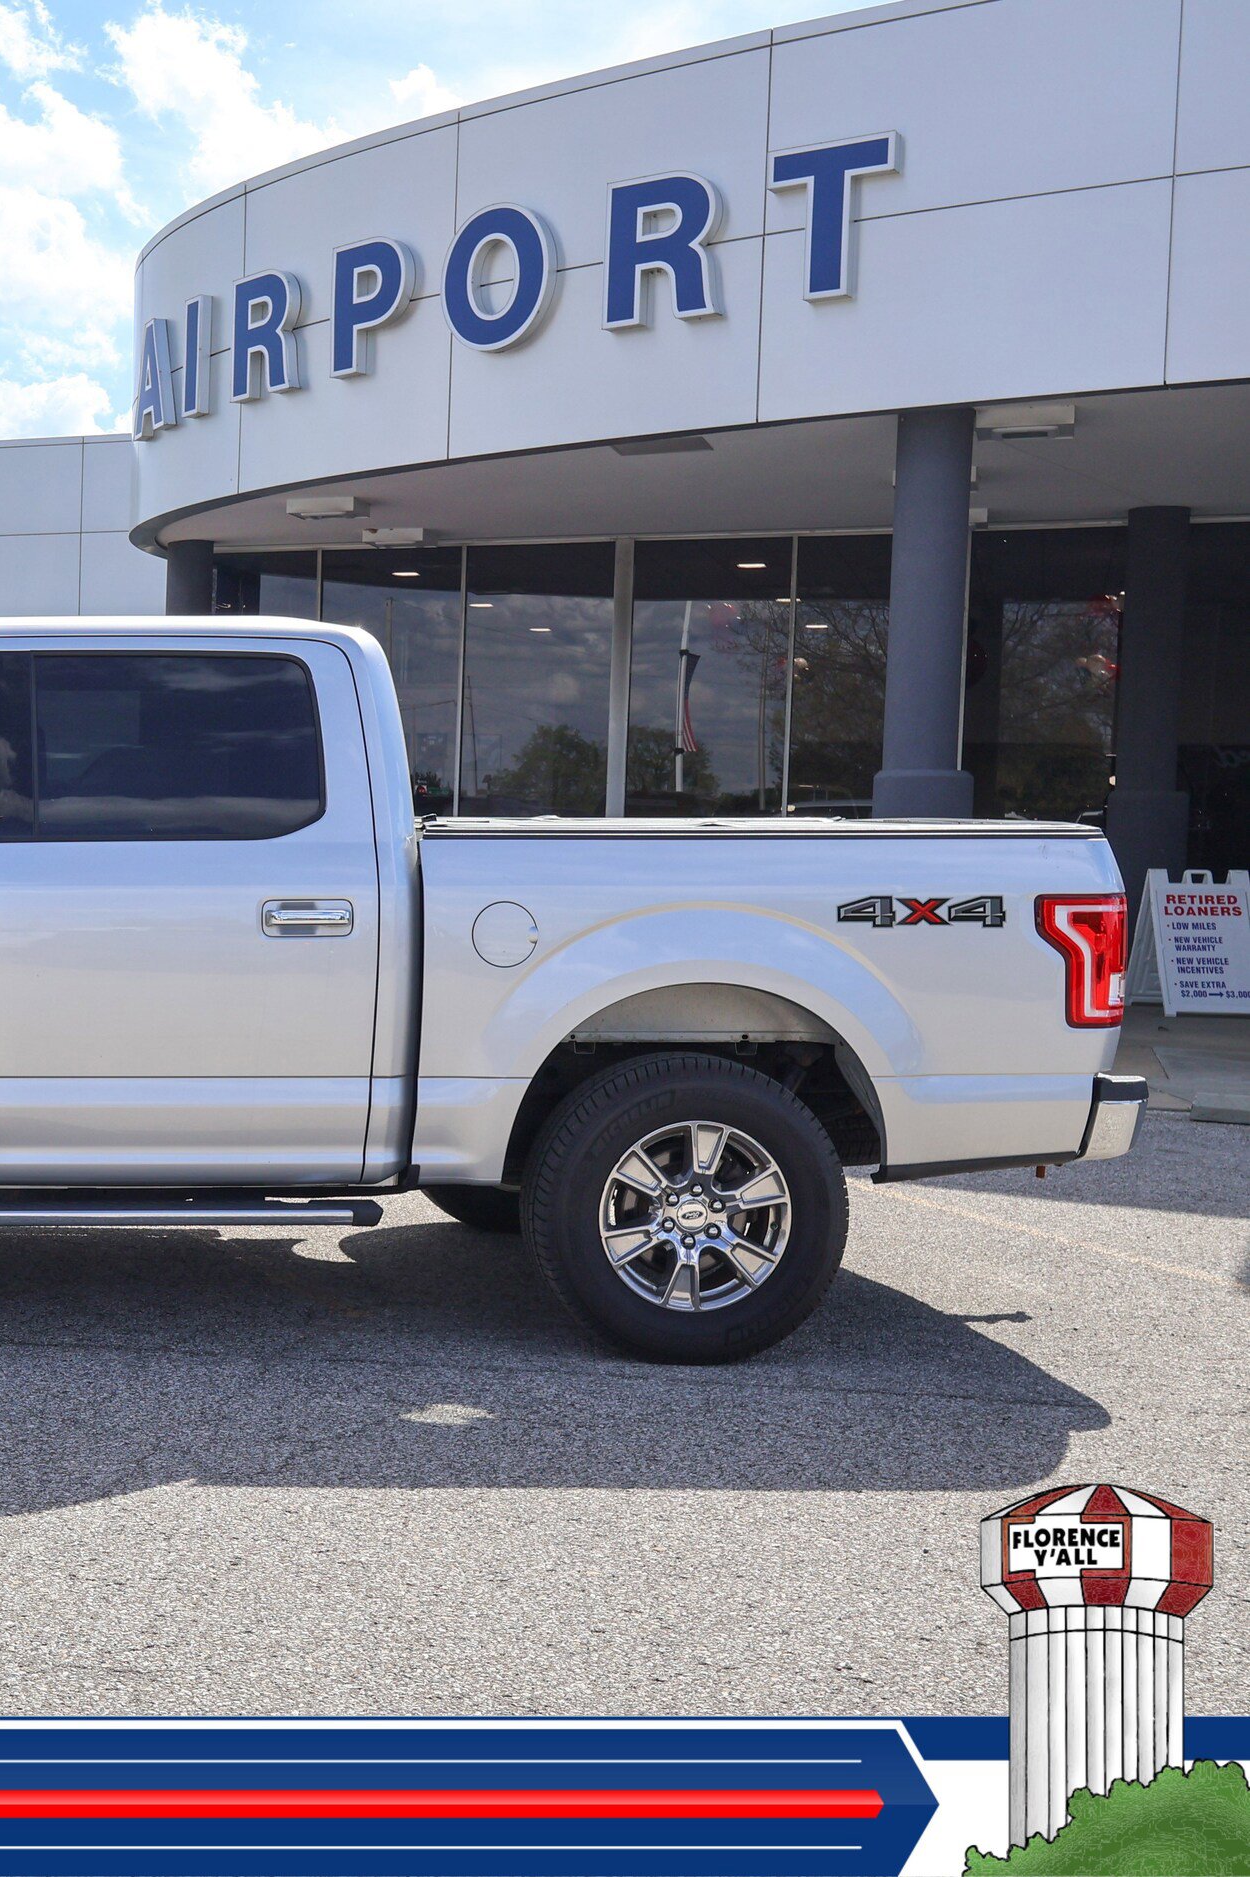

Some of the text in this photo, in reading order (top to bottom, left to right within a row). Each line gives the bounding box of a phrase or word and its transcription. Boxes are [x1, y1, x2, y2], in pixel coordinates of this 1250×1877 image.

[134, 130, 901, 441] AIRPORT
[1166, 895, 1237, 904] RETIRED
[1164, 906, 1242, 916] LOANERS
[1172, 922, 1189, 930] LOW
[1181, 990, 1207, 998] $2,000
